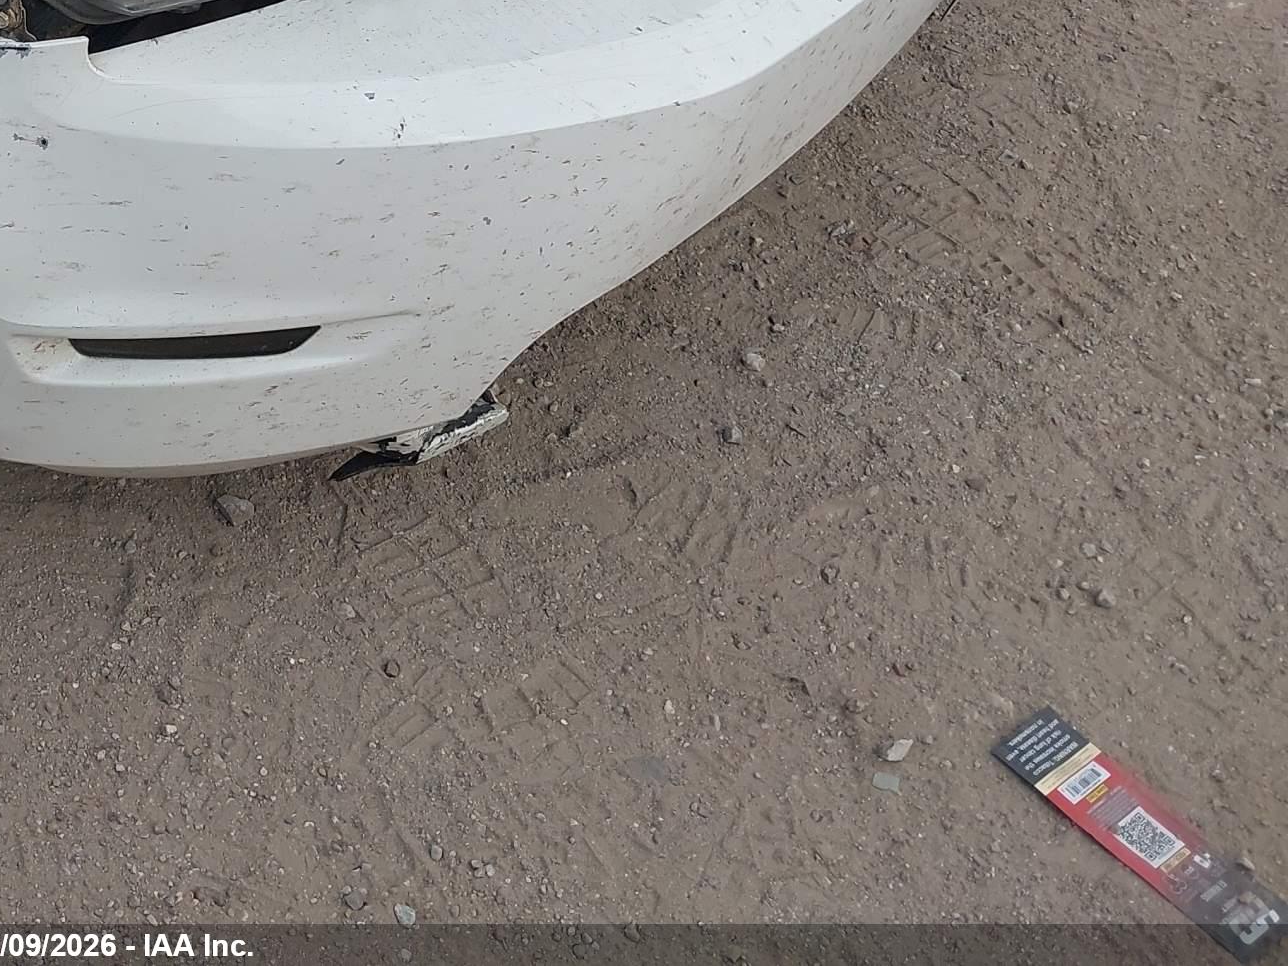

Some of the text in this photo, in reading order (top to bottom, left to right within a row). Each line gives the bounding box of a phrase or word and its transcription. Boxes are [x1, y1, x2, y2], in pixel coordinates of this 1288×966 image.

[1036, 718, 1044, 726] in
[1047, 718, 1059, 729] and
[1035, 726, 1051, 738] heart
[1019, 729, 1062, 763] risk of lung cancer
[1024, 733, 1071, 770] smoke increases the
[1005, 749, 1019, 761] even
[1032, 760, 1055, 776] Tobacco
